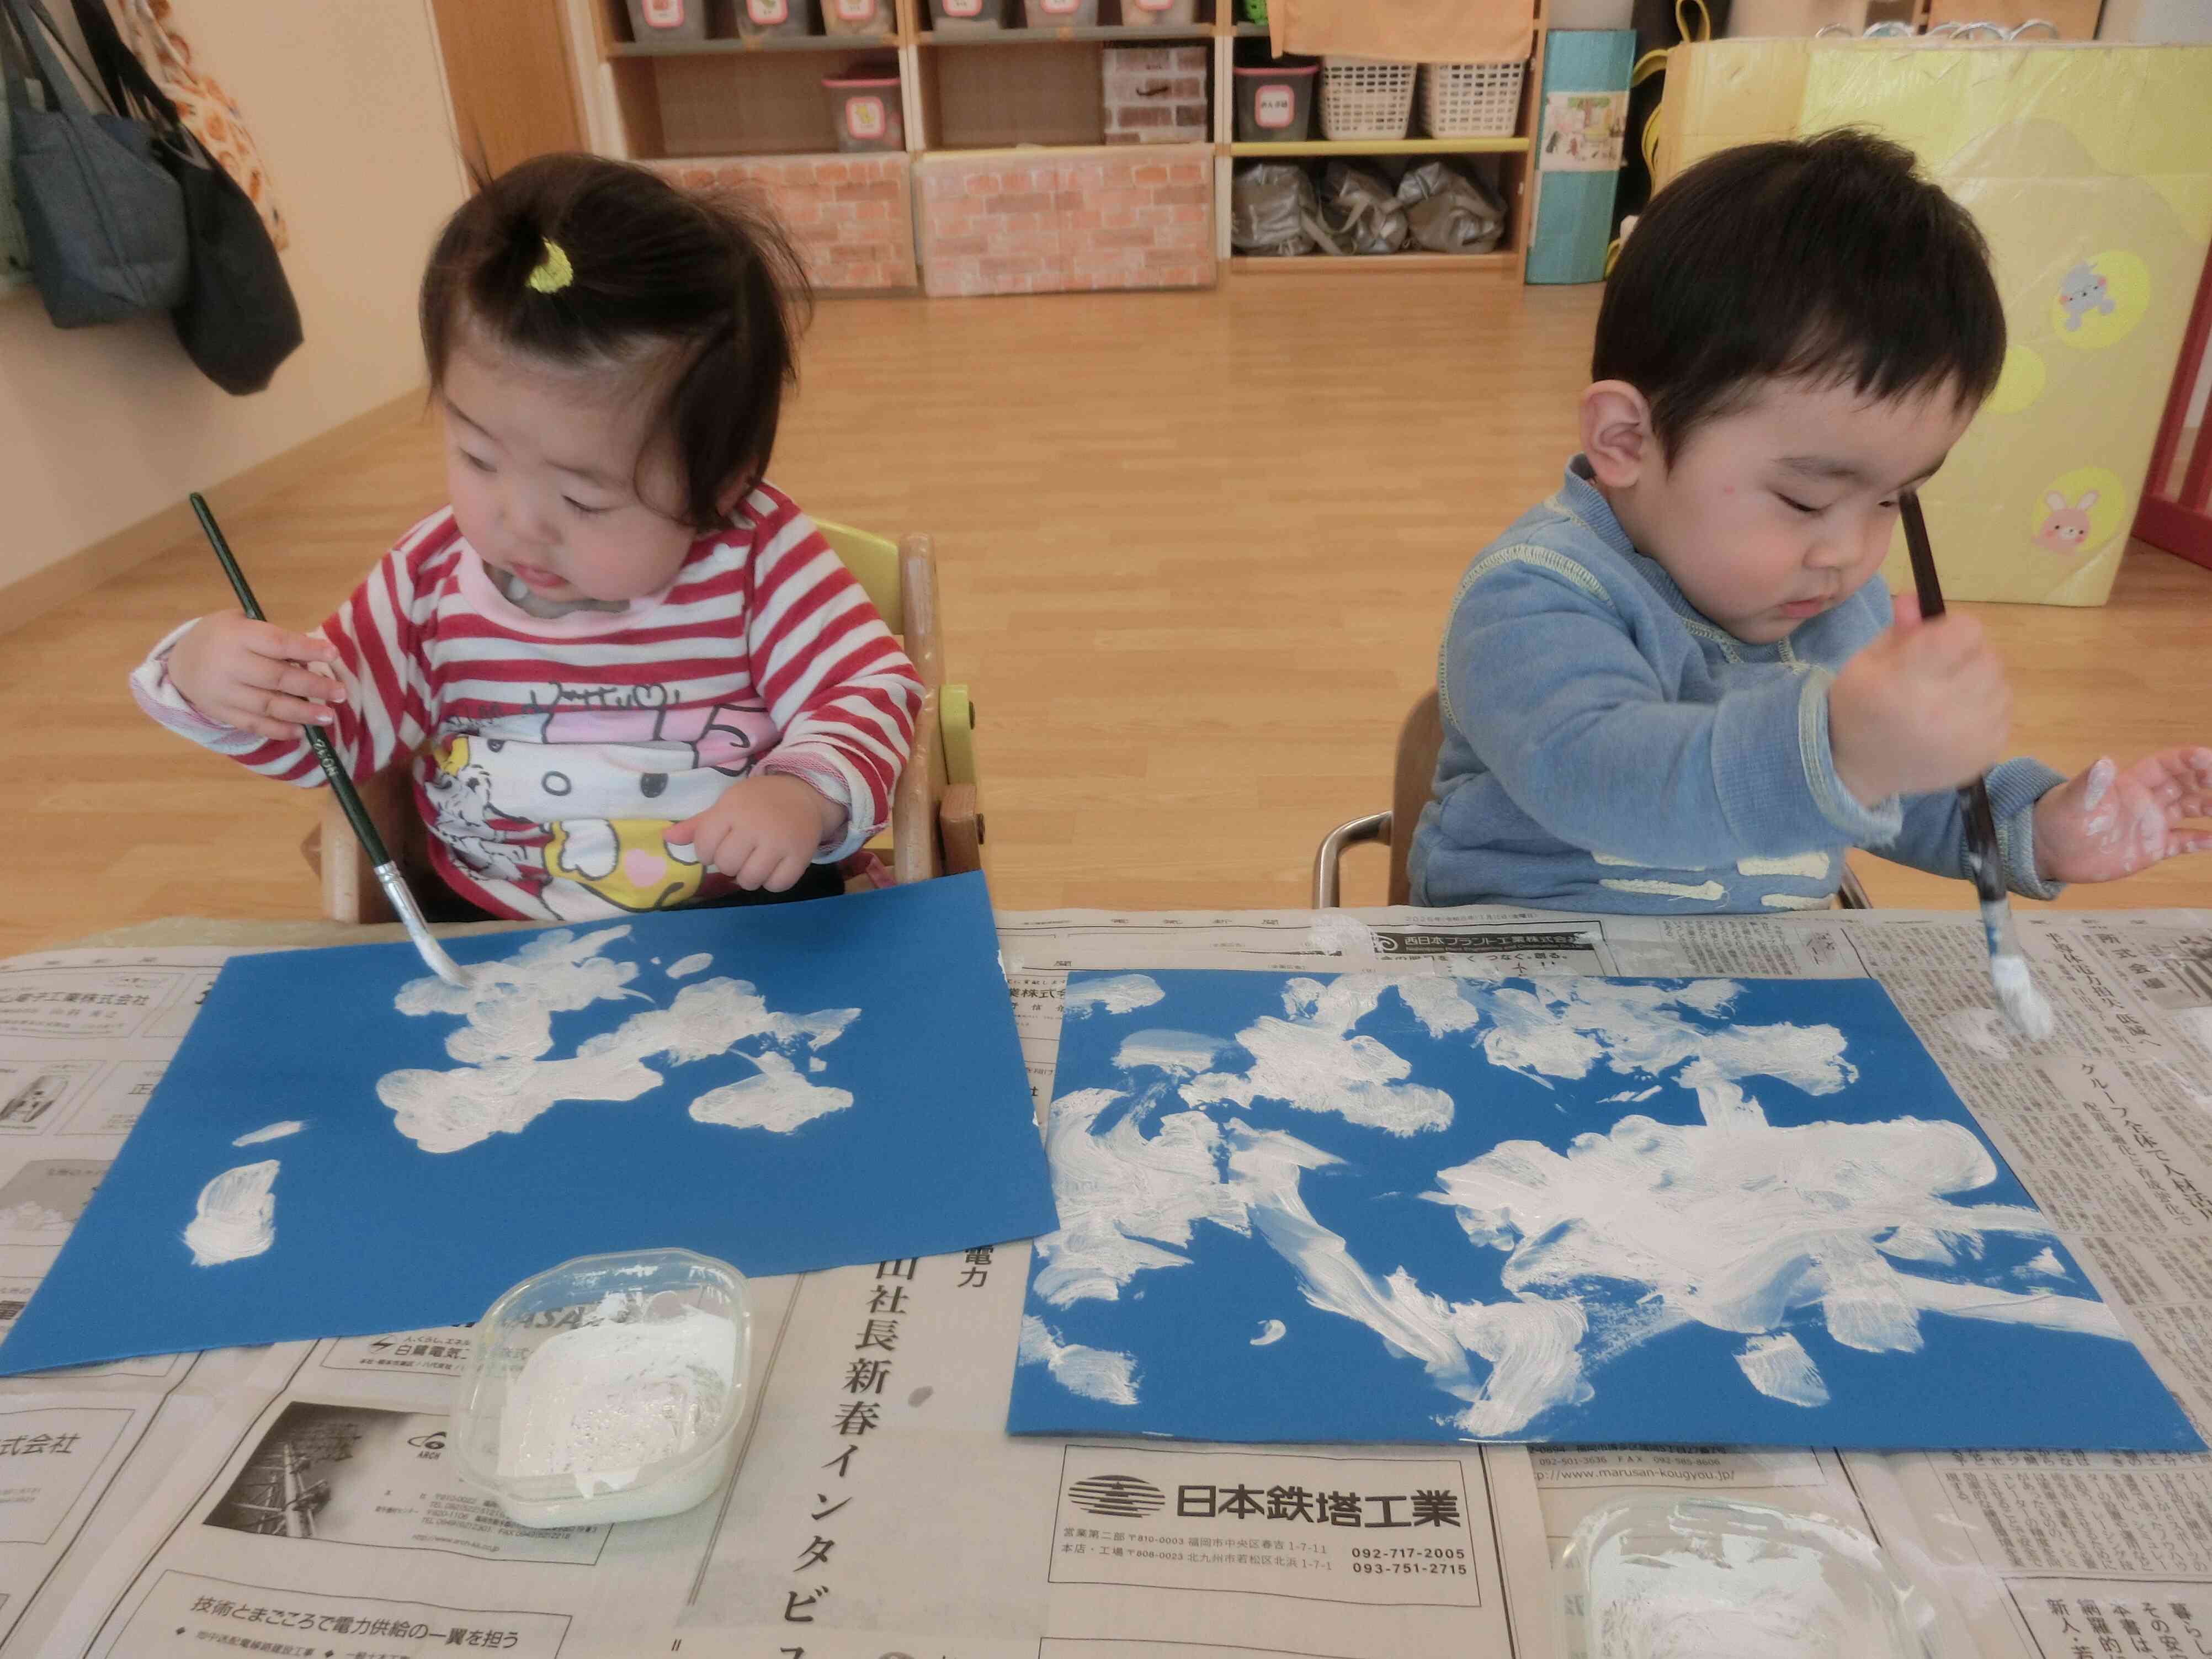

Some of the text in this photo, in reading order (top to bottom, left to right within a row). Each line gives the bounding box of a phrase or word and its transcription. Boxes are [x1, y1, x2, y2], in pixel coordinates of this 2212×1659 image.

[957, 1245, 993, 1288] 電力
[0, 1433, 80, 1456] 式会社
[417, 1450, 441, 1460] ARCH
[1176, 1483, 1461, 1528] 日本鉄塔工業
[1064, 1527, 1125, 1541] 営業第二部
[1188, 1537, 1285, 1551] 福岡市中央区春吉
[1062, 1544, 1123, 1557] 本店・工場
[1188, 1553, 1298, 1568] 北九州市若松区北浜
[1302, 1559, 1332, 1571] 1-7-1
[1352, 1547, 1465, 1560] 092-717-2005
[1353, 1562, 1467, 1576] 093-751-2715
[190, 1595, 519, 1649] 技術とまごころで電力供給の一翼を担う
[2077, 1598, 2128, 1659] 網羅的
[2141, 1602, 2189, 1659] その安
